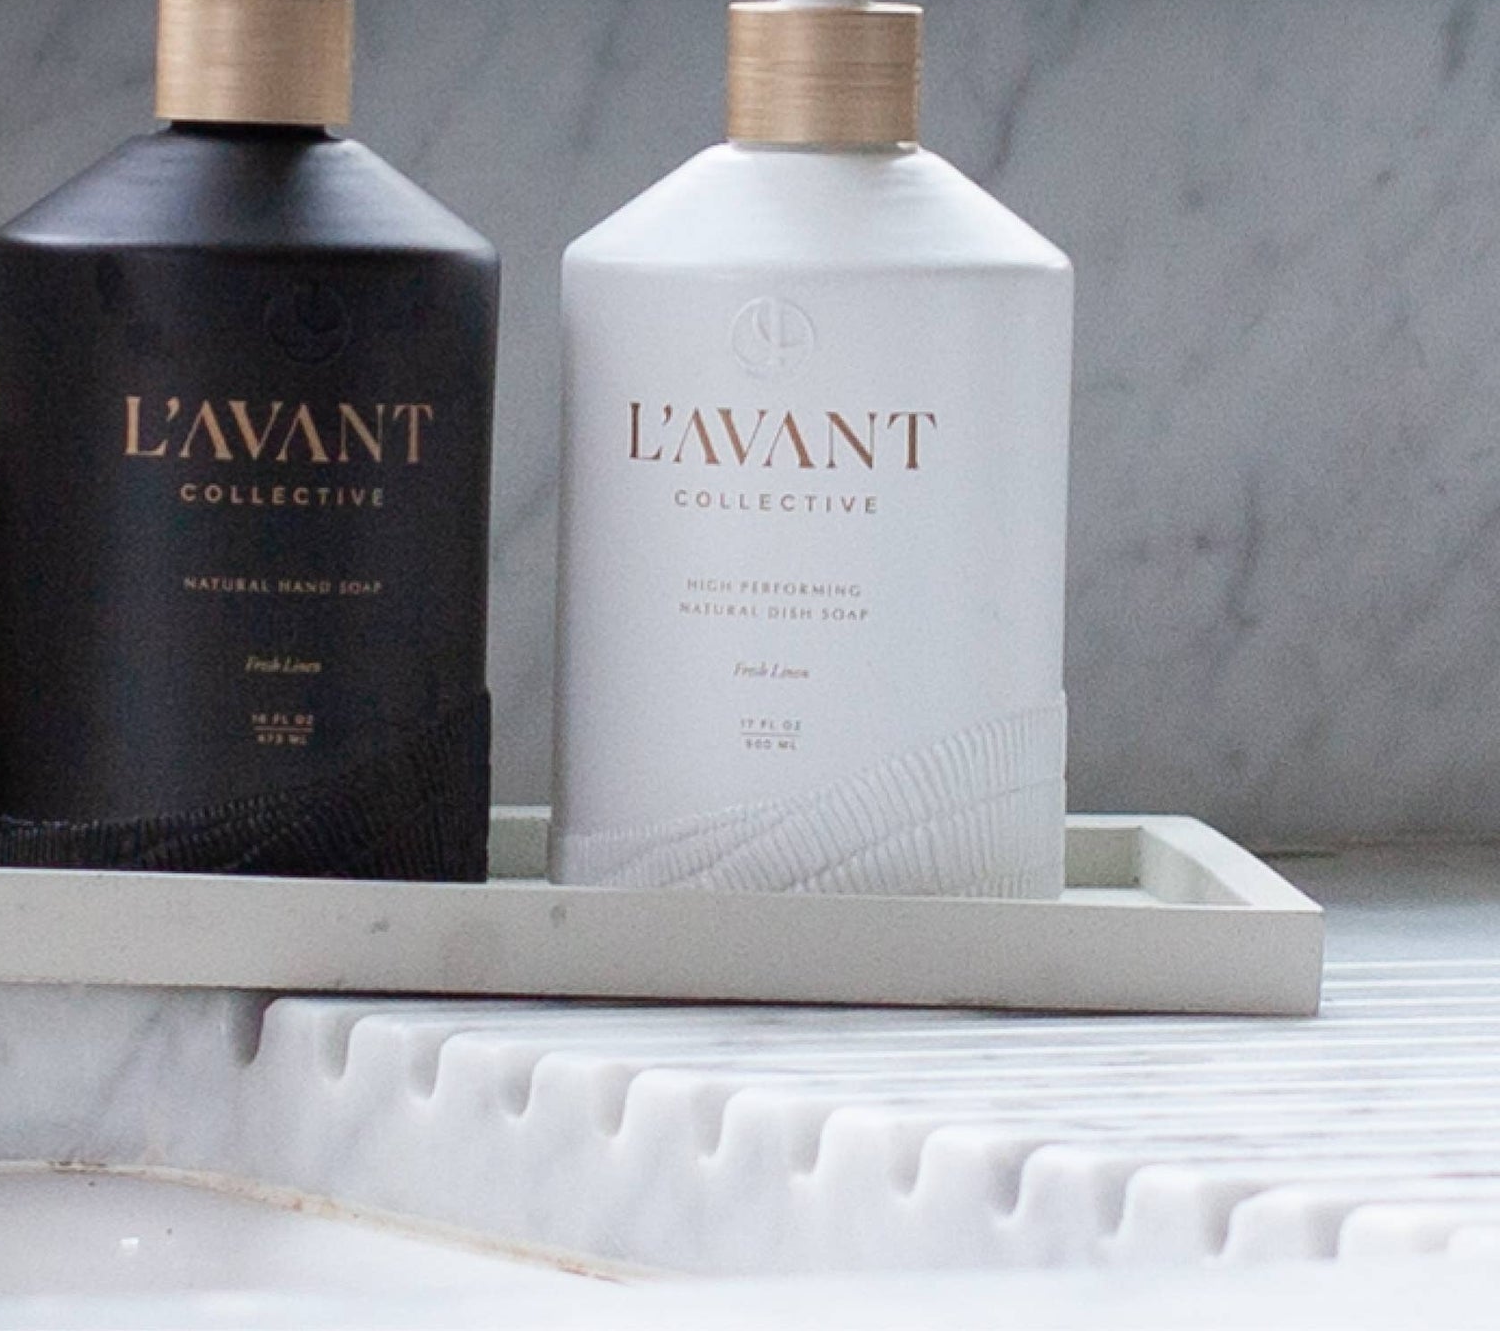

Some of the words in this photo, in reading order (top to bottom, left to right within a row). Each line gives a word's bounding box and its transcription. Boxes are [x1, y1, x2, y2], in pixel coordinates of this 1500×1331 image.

[123, 395, 434, 464] L'AVANT
[627, 401, 938, 471] L'AVANT
[180, 482, 384, 508] COLLECTIVE
[674, 488, 880, 515] COLLECTIVE
[184, 575, 270, 594] NATURAL
[277, 579, 332, 596] HAND
[339, 580, 383, 596] SOAP
[686, 578, 733, 593] HIGH
[740, 580, 862, 598] PERFORMING
[678, 601, 759, 619] NATURAL
[767, 606, 813, 621] DISH
[821, 607, 870, 622] SOAP
